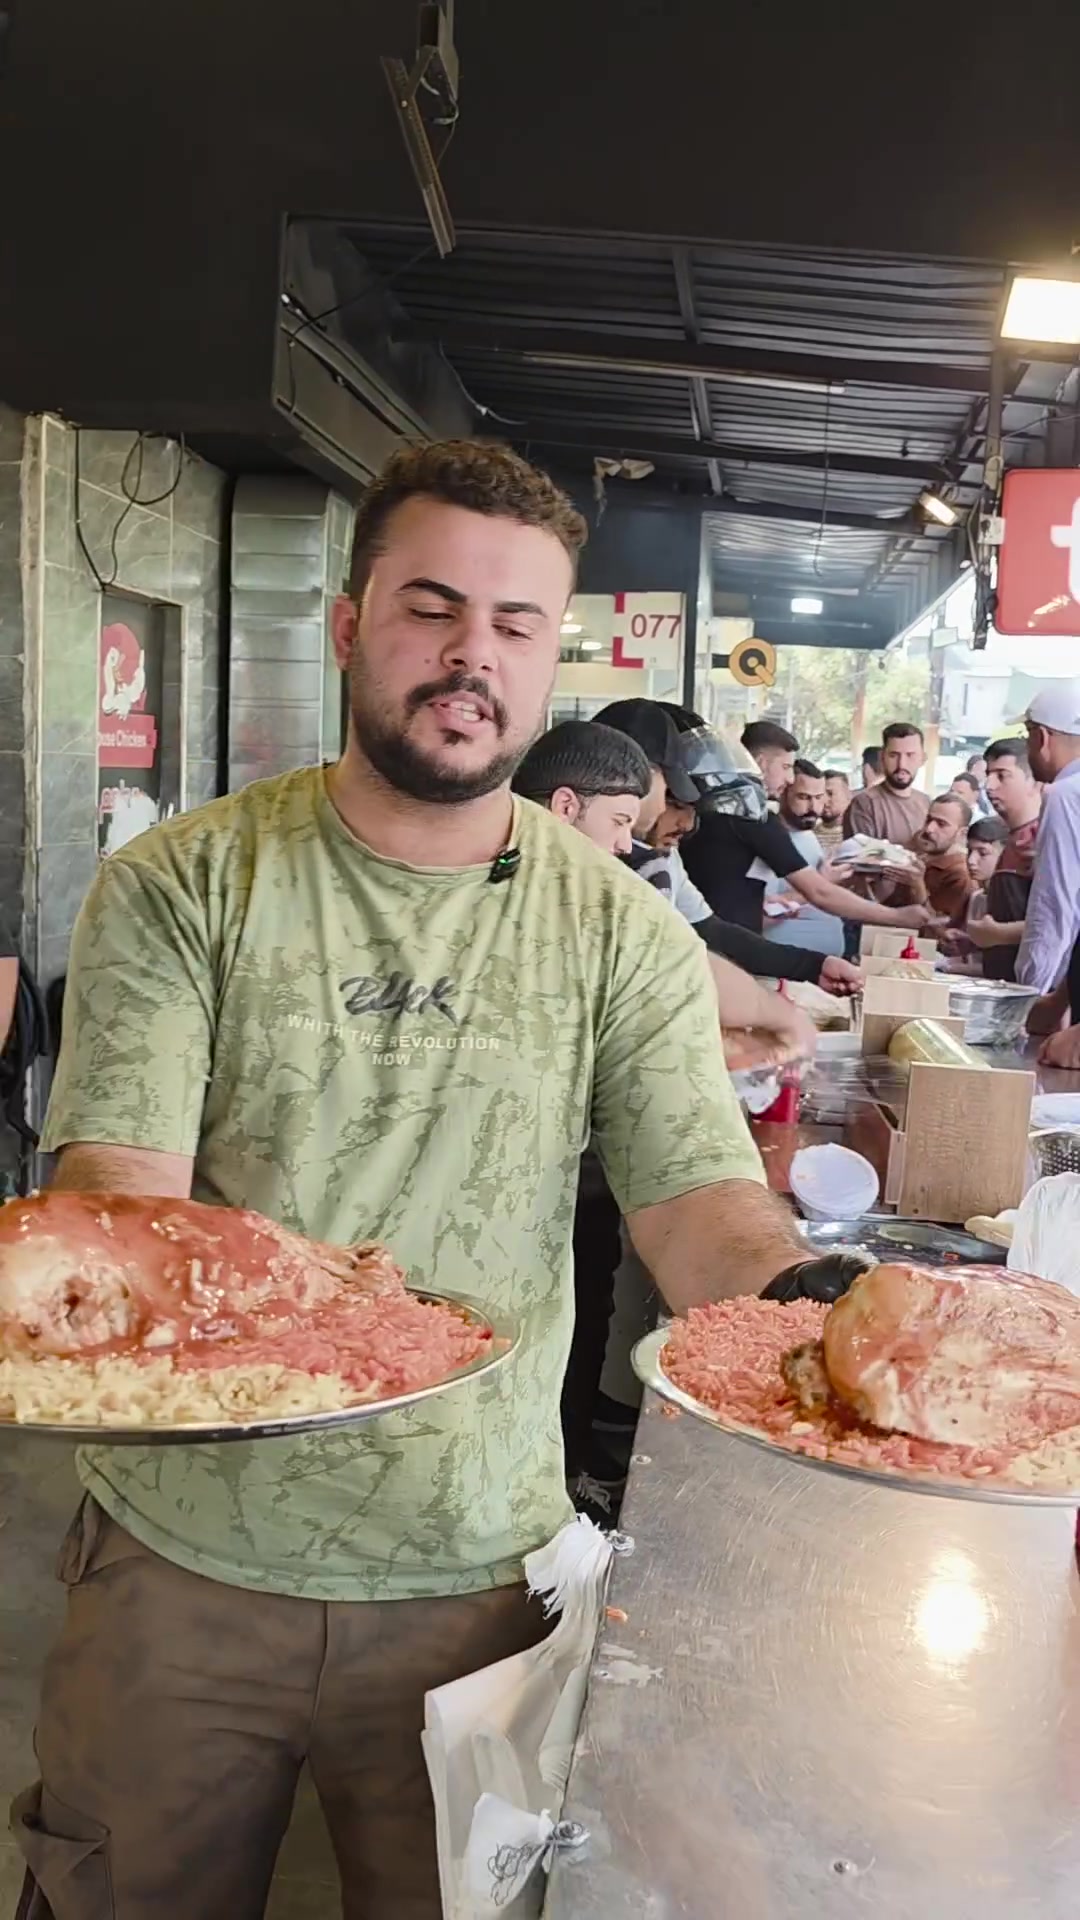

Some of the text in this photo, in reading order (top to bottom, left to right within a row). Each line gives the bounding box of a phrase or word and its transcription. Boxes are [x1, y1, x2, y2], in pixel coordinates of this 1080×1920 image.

[631, 613, 682, 639] 077
[116, 729, 147, 747] Chicken
[287, 1013, 501, 1051] WHITH THE REVOLUTION
[372, 1051, 411, 1066] NOW
